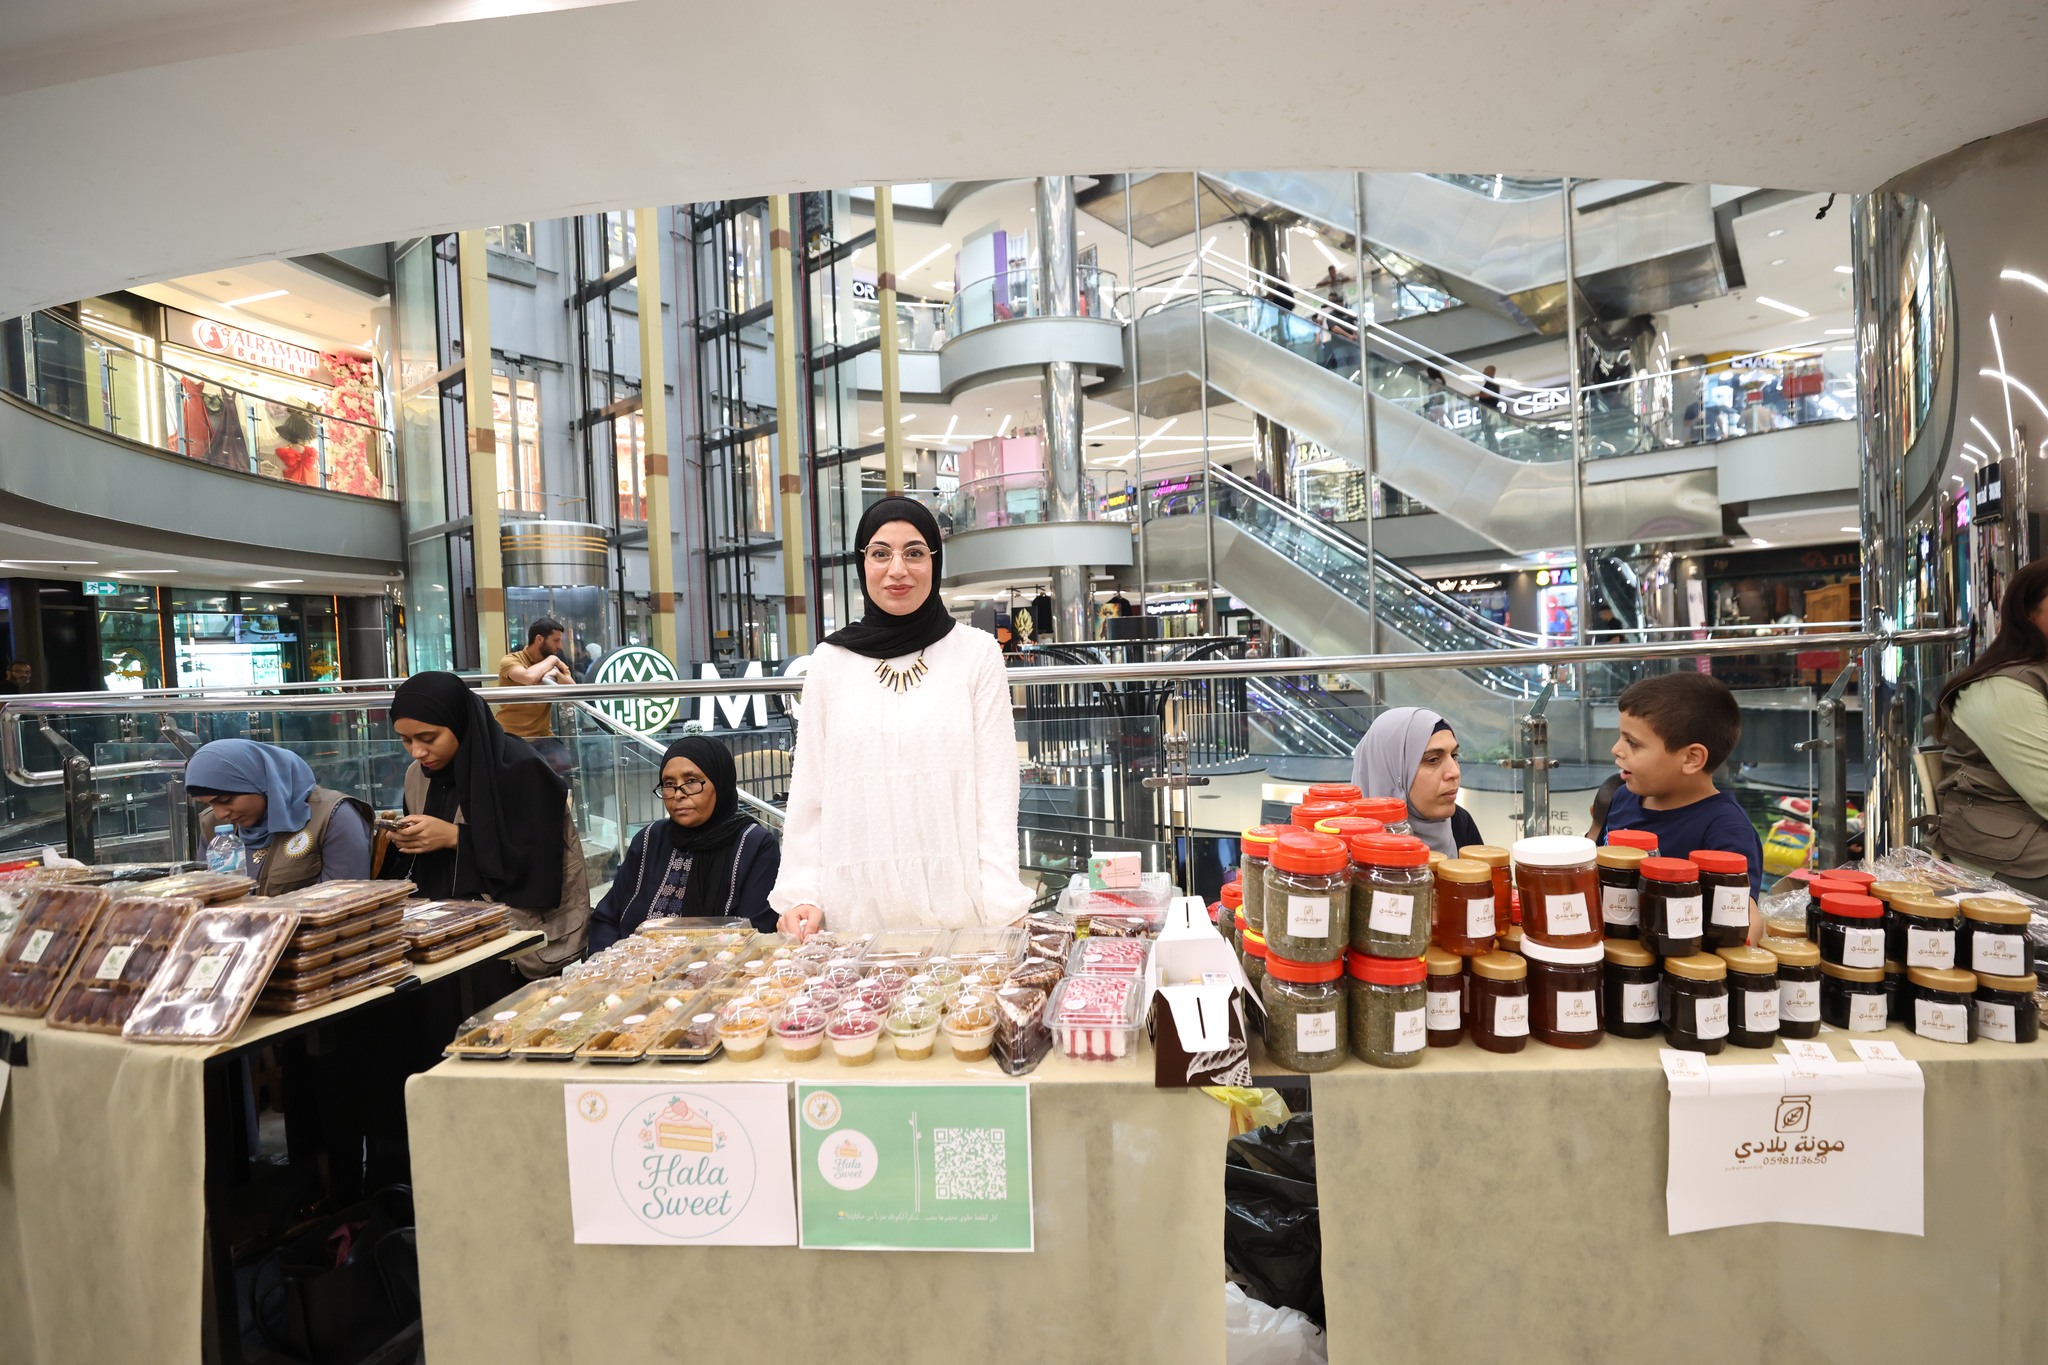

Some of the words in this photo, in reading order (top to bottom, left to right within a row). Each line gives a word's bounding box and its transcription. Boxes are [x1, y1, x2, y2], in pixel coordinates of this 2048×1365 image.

[234, 330, 319, 368] ALRAMAHI
[1734, 1136, 1788, 1164] بلادي
[1794, 1135, 1845, 1157] مونة
[637, 1153, 729, 1190] Hala
[832, 1157, 863, 1170] Hala
[1762, 1155, 1828, 1166] 0598113650
[833, 1168, 864, 1179] Sweet
[641, 1186, 733, 1220] Sweet
